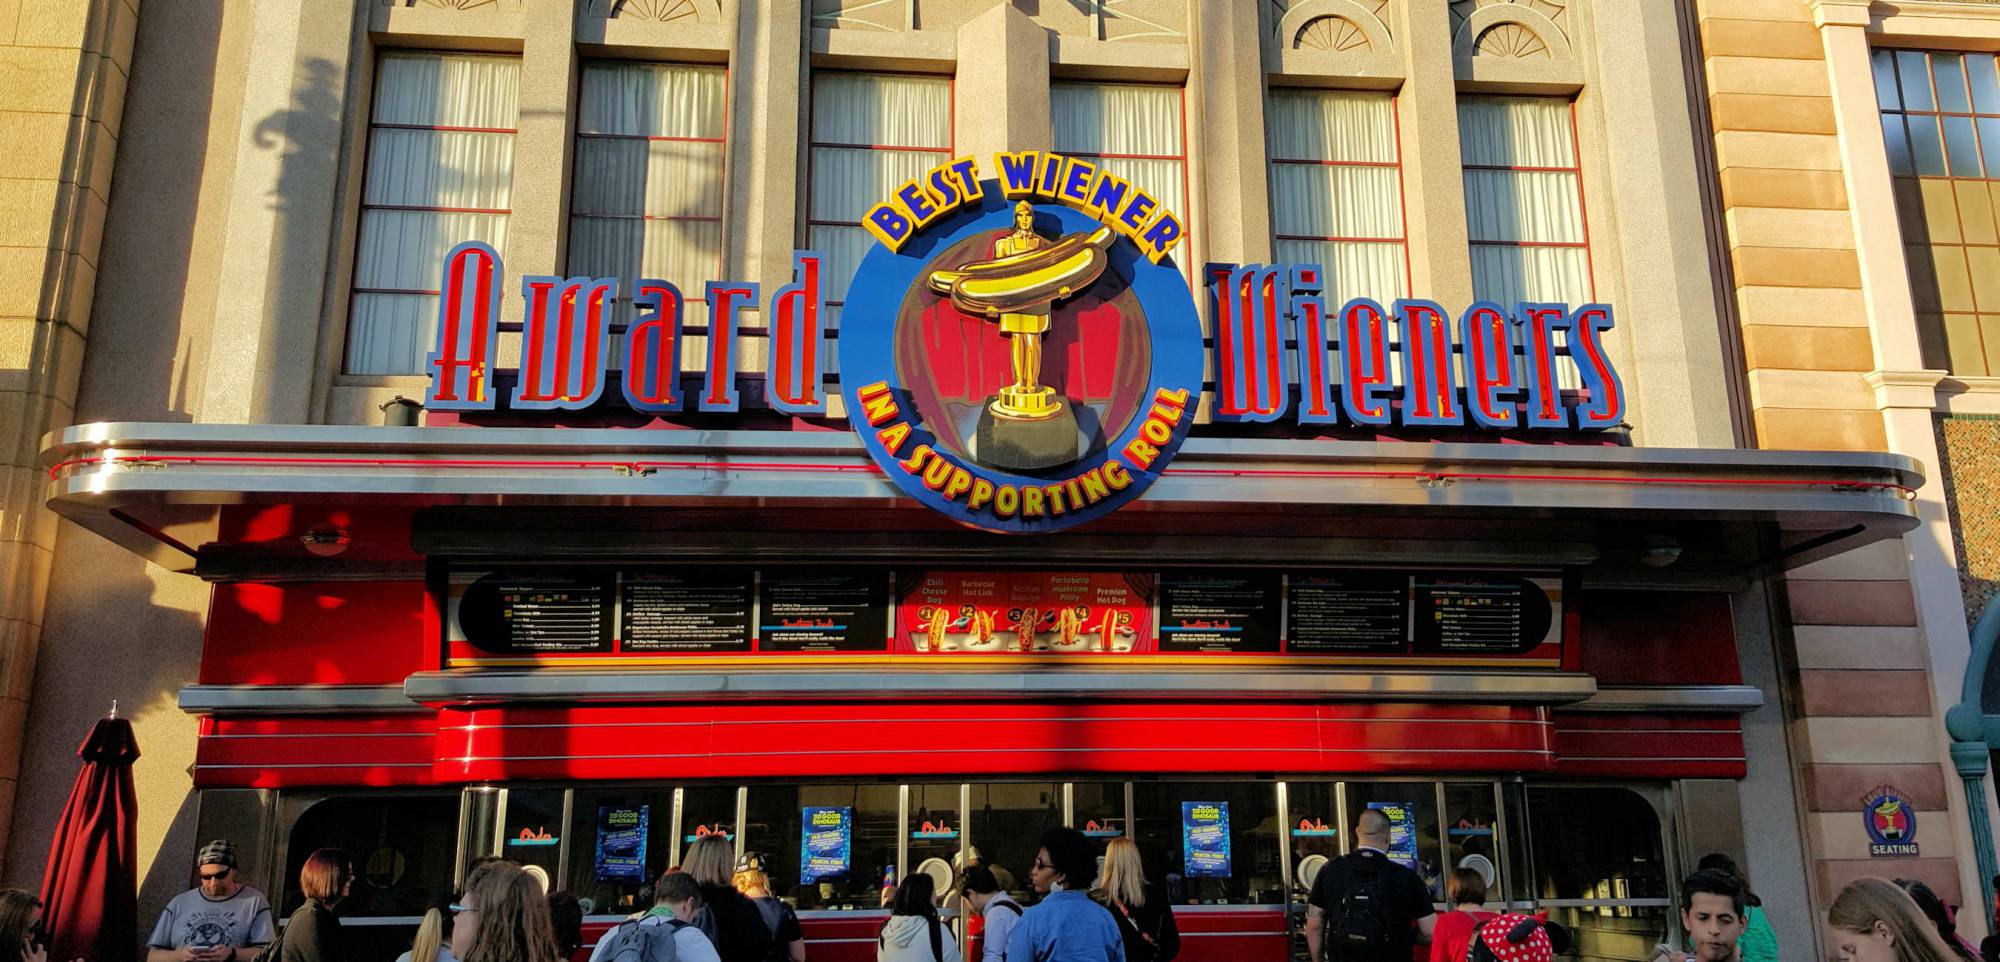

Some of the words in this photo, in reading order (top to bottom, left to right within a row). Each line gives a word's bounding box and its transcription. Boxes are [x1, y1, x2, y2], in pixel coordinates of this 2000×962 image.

[862, 155, 984, 254] BEST
[994, 151, 1185, 264] WIENER
[424, 240, 827, 414] Award
[1204, 262, 1626, 429] Wieners
[857, 381, 899, 426] IN
[877, 421, 912, 457] A
[1122, 386, 1191, 470] ROLL
[899, 444, 1133, 517] SUPPORTING
[927, 596, 942, 605] Dog
[963, 588, 976, 597] Hot
[1096, 587, 1128, 596] Premium
[1096, 596, 1110, 604] Hot
[1111, 596, 1127, 605] Dog
[1872, 844, 1918, 854] SEATING
